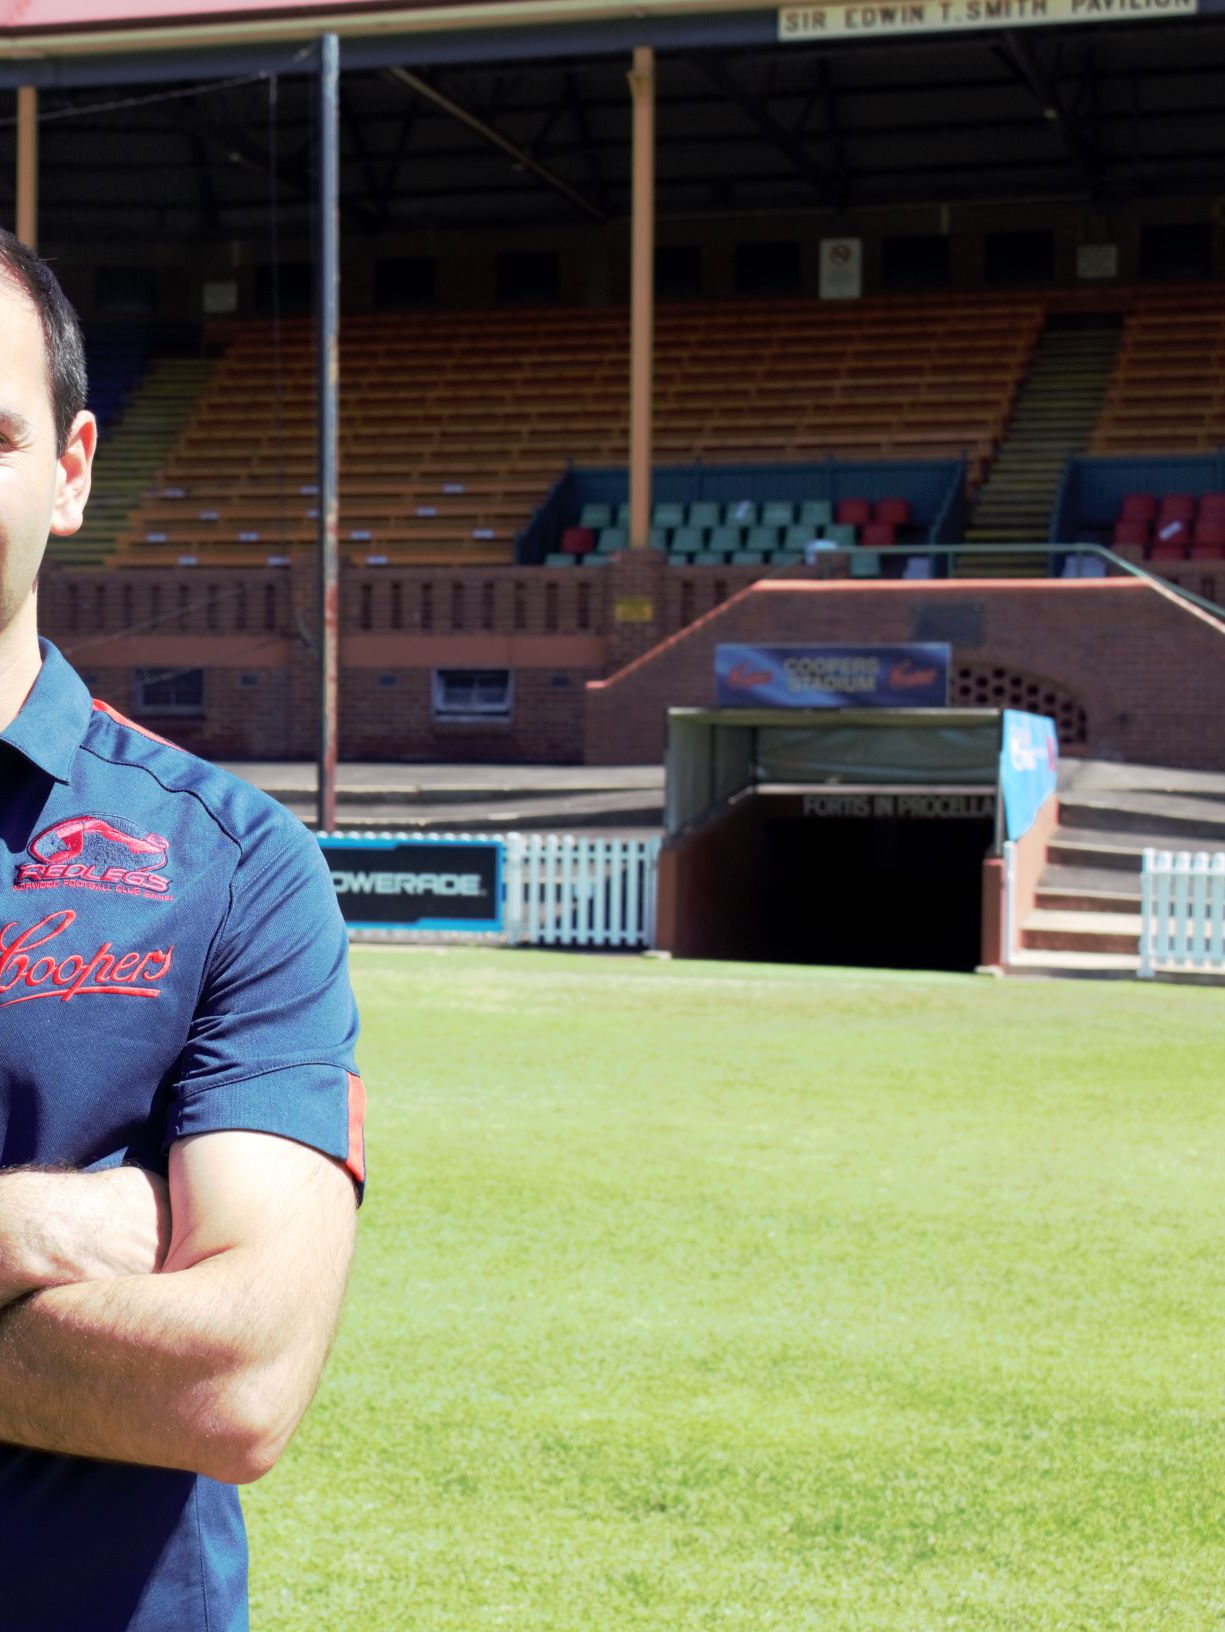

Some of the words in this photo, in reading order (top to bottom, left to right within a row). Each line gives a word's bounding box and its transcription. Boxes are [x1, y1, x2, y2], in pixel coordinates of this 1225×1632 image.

[785, 9, 826, 32] SIR
[845, 5, 925, 29] EDWIN
[16, 863, 170, 892] REDLEGS
[329, 871, 482, 896] OWERADE
